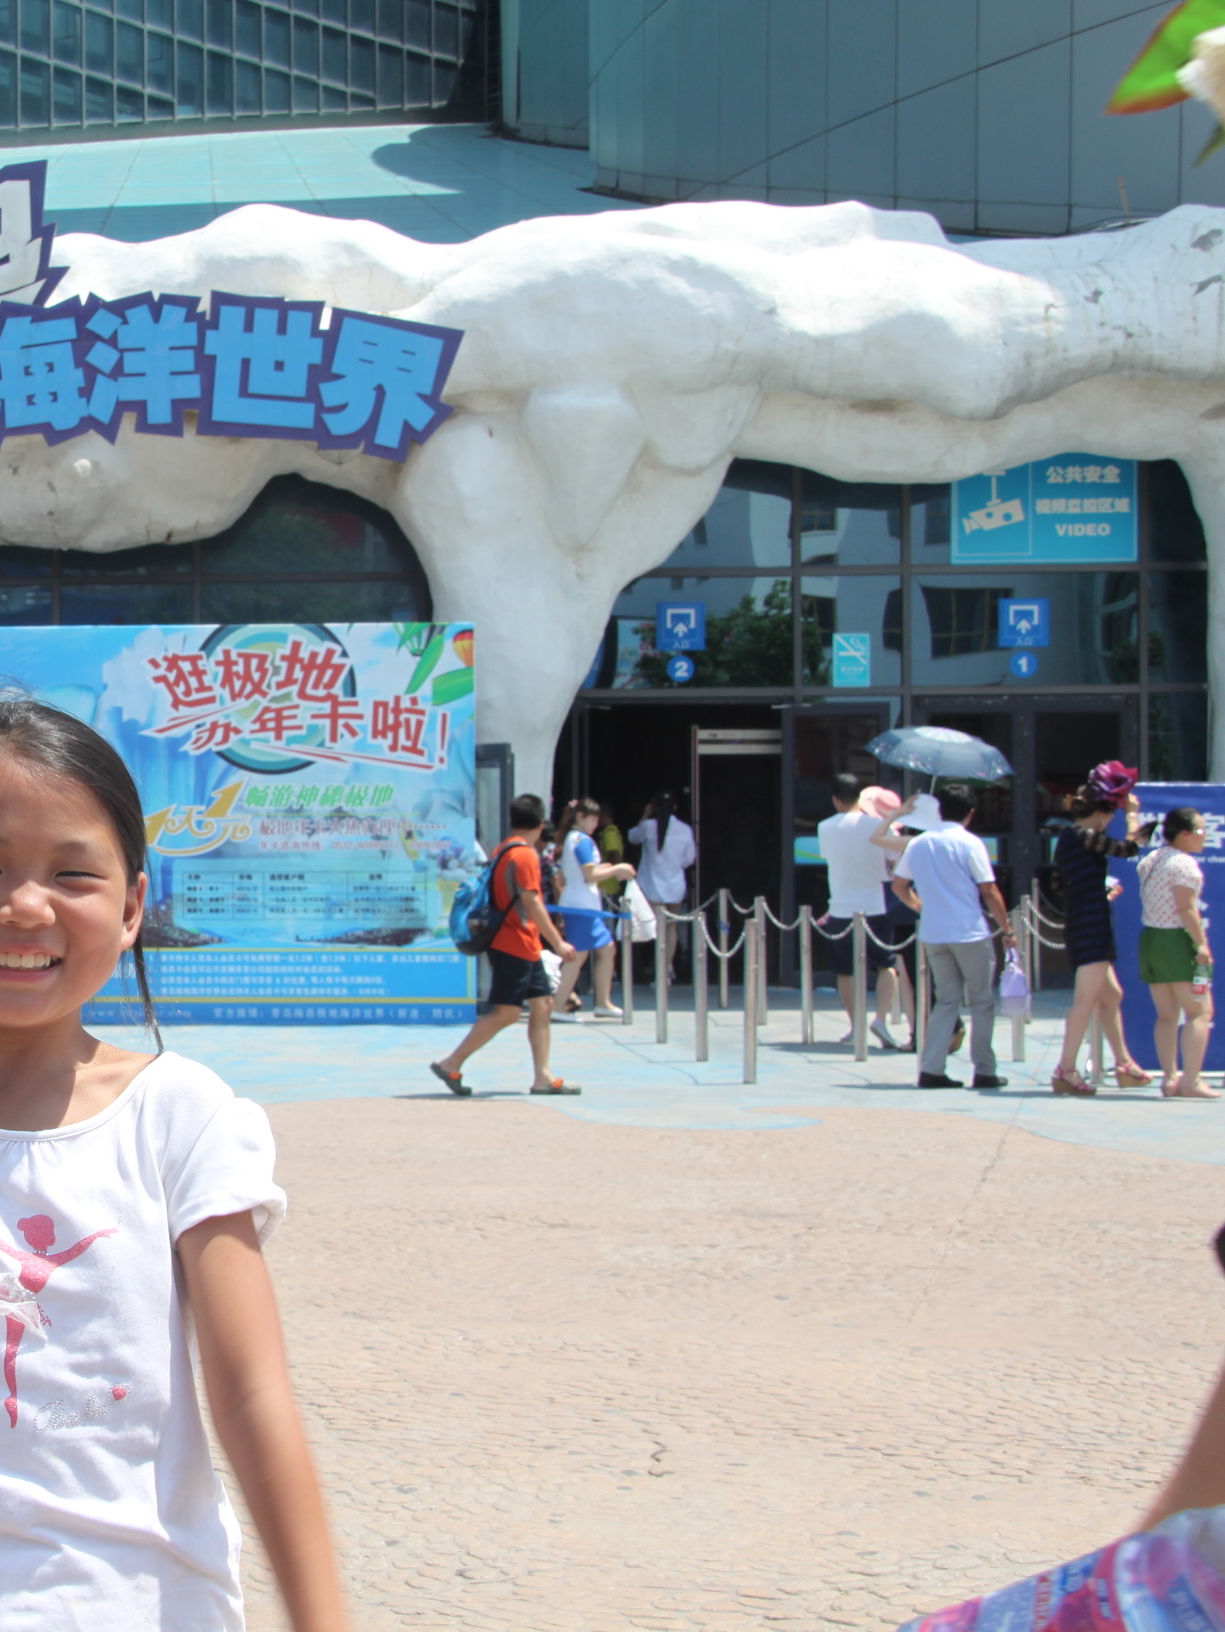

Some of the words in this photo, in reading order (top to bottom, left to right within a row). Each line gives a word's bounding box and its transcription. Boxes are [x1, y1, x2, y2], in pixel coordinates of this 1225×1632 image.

[1045, 464, 1121, 484] 公共安全
[1055, 522, 1112, 537] VIDEO
[674, 661, 689, 678] 2
[1017, 656, 1029, 674] 1
[146, 639, 349, 712] 逛极地
